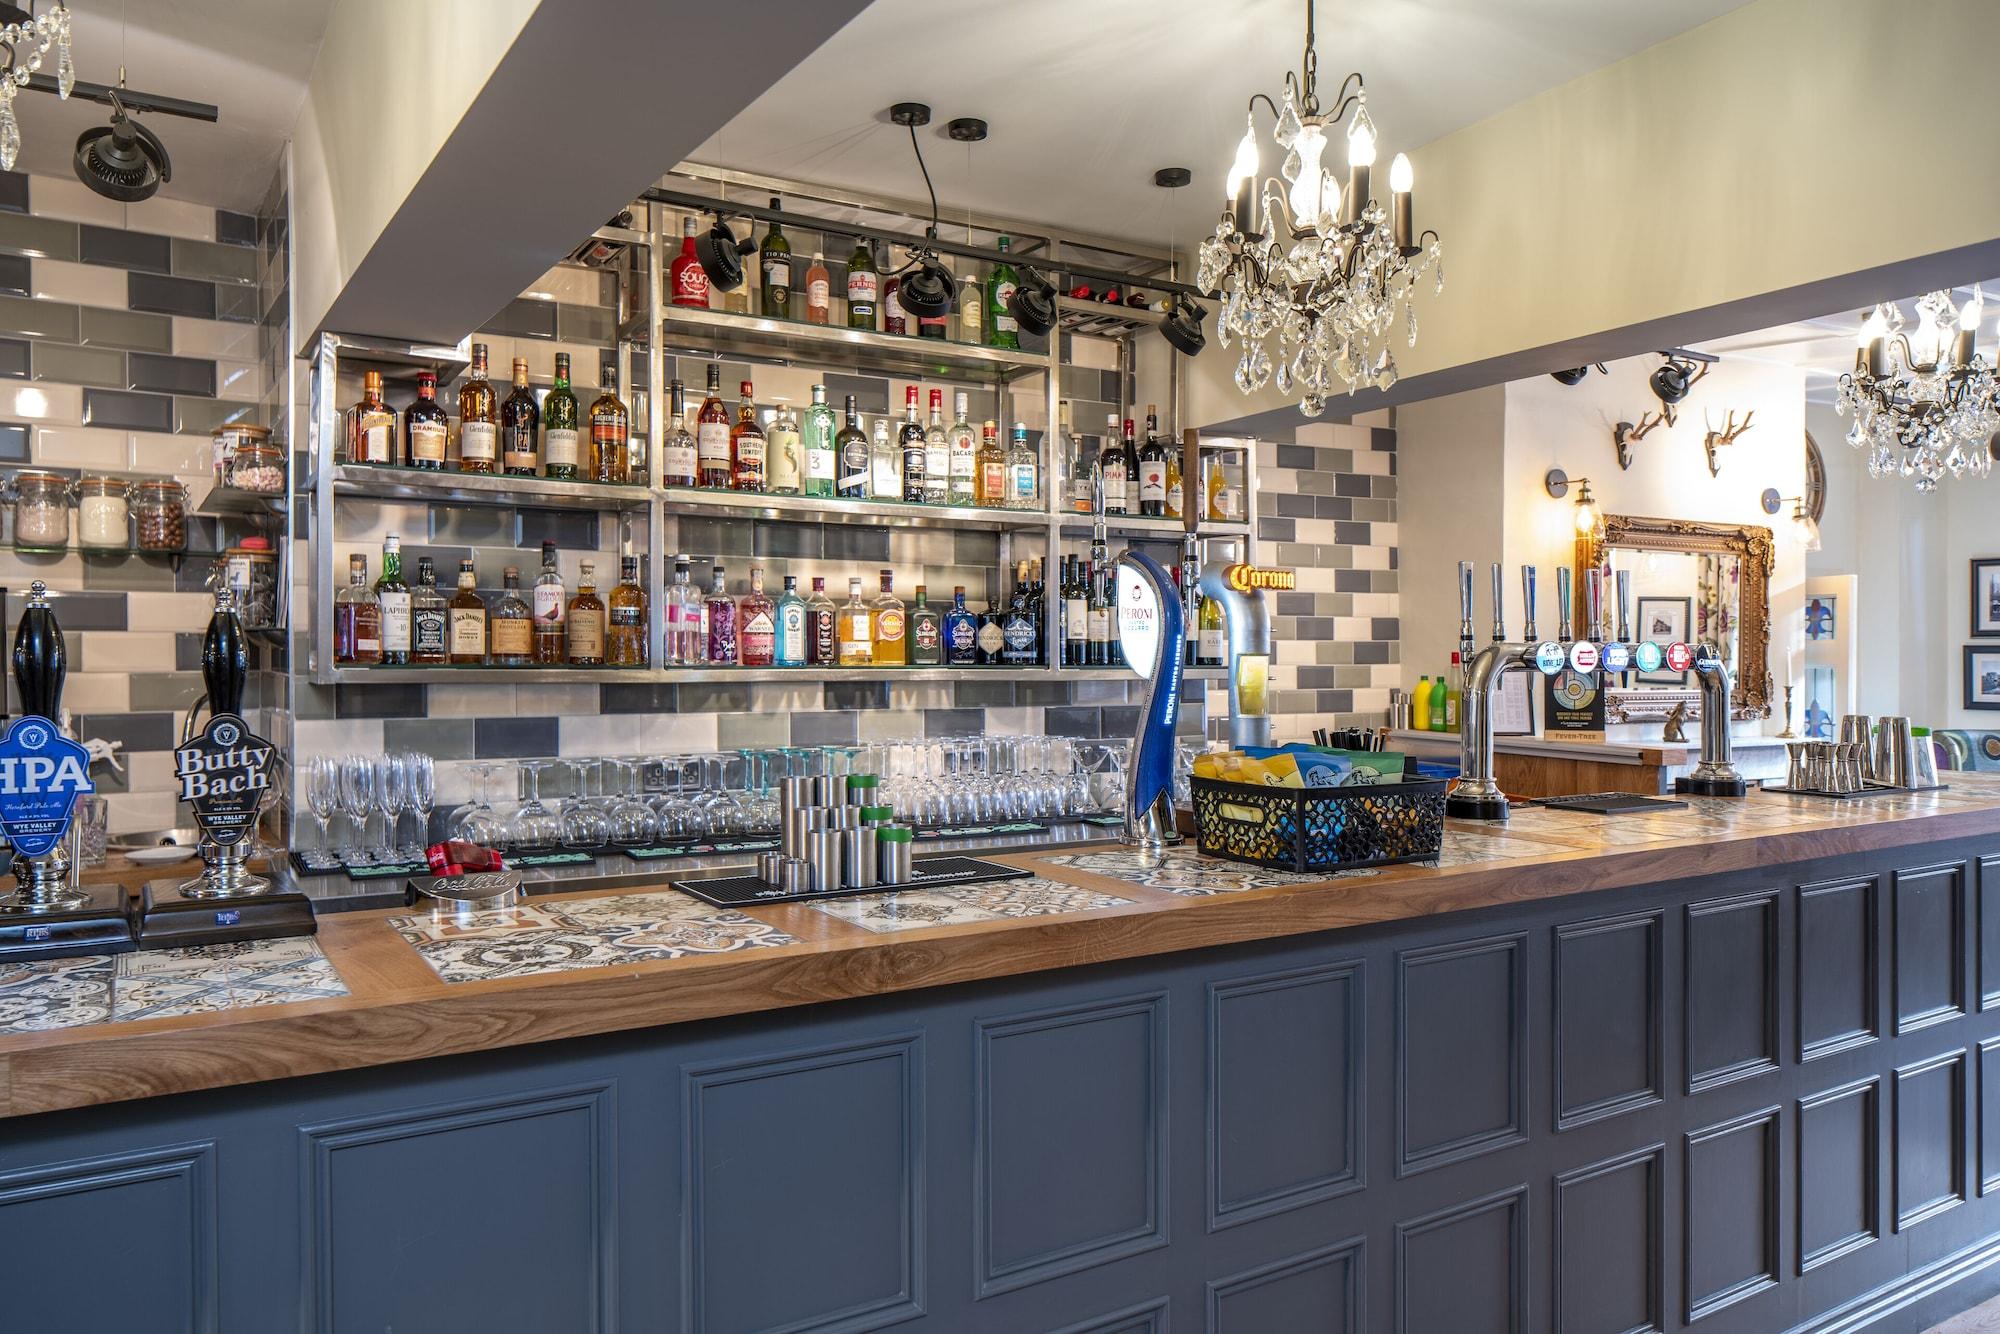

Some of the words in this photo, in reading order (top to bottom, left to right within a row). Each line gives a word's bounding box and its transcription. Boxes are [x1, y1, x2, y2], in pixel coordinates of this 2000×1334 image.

[412, 424, 445, 433] DRAMBUIE
[739, 442, 763, 450] SOUTHERN
[811, 456, 820, 470] 3
[1230, 564, 1295, 593] Corona
[1121, 607, 1152, 619] PERONI
[400, 623, 407, 631] 10
[1163, 693, 1176, 725] PERONI
[177, 745, 272, 775] Butty
[182, 765, 270, 800] Bach
